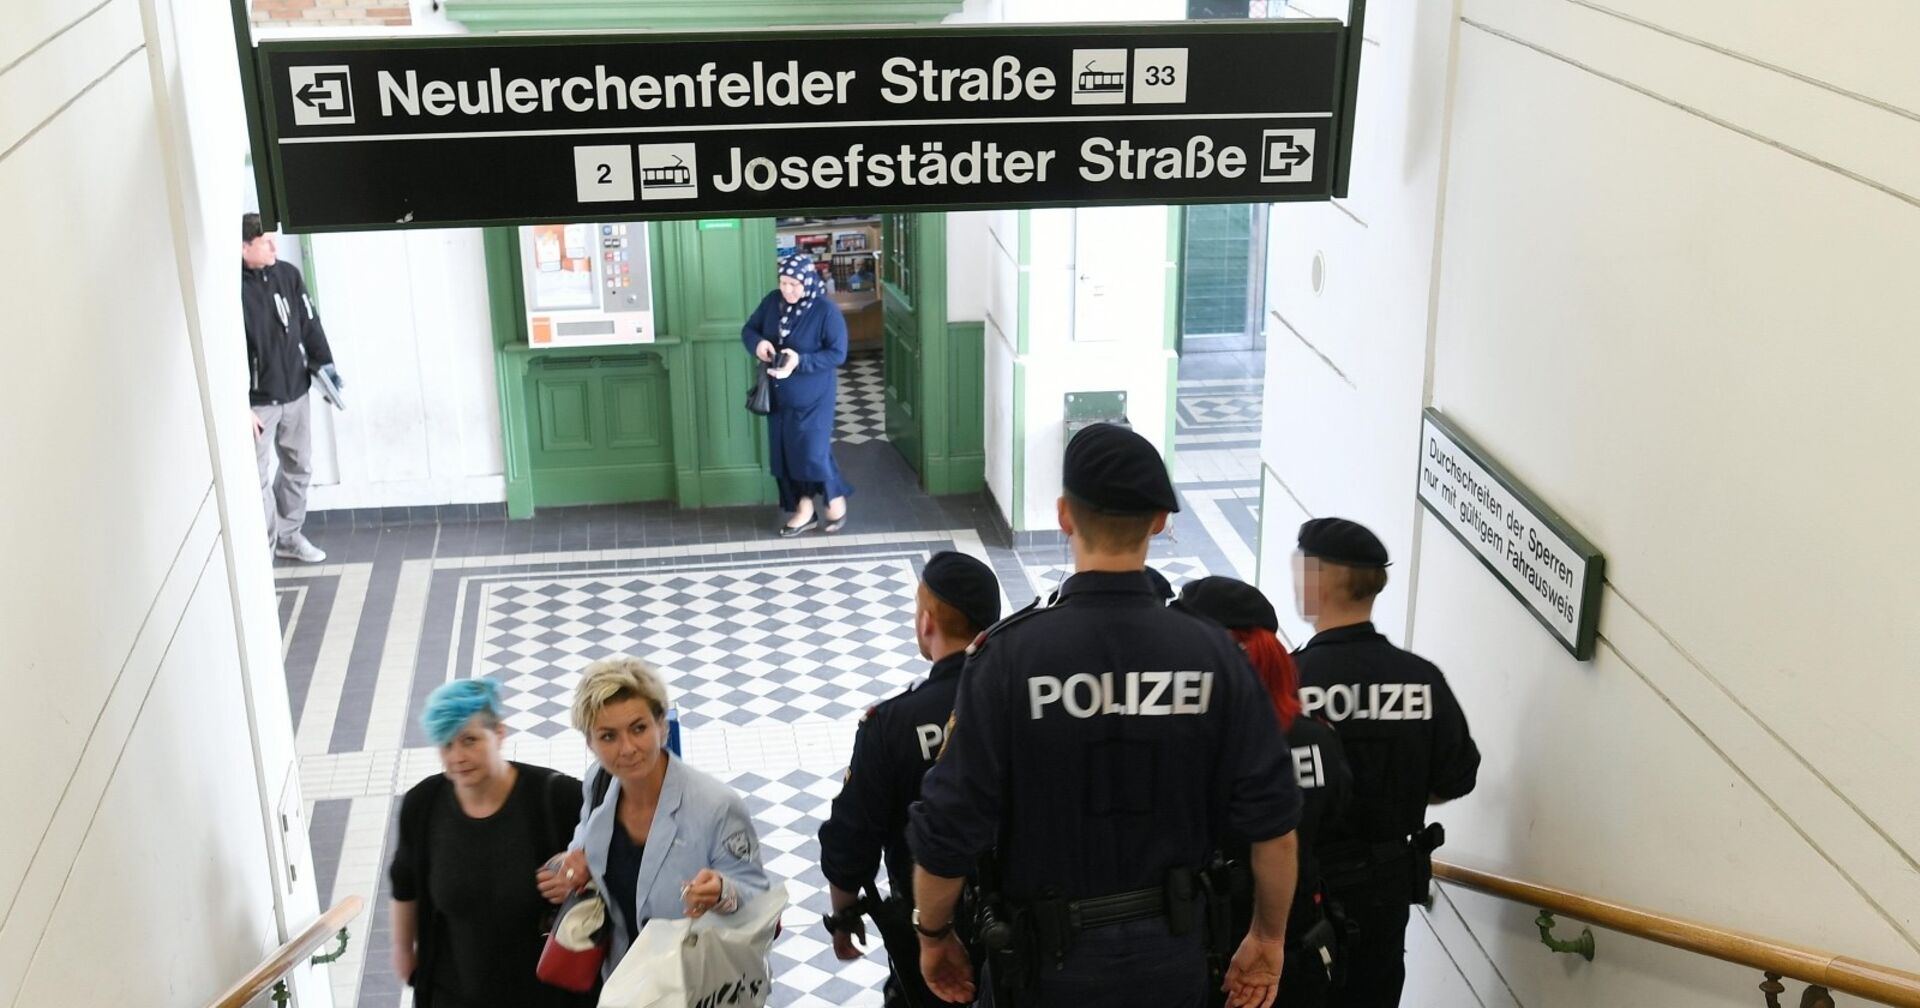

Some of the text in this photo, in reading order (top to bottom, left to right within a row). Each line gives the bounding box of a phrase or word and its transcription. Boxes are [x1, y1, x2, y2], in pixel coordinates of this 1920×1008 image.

[378, 55, 1176, 117] Neulerchenfelder Straße 33
[596, 135, 1246, 193] 2 Josefstädter Straße
[1430, 437, 1573, 588] Durchschreiten der Sperren
[1424, 467, 1574, 623] nur mit gültigem Fahrausweis
[1028, 671, 1214, 719] POLIZEI
[1298, 683, 1433, 722] POLIZEI
[916, 723, 949, 761] P
